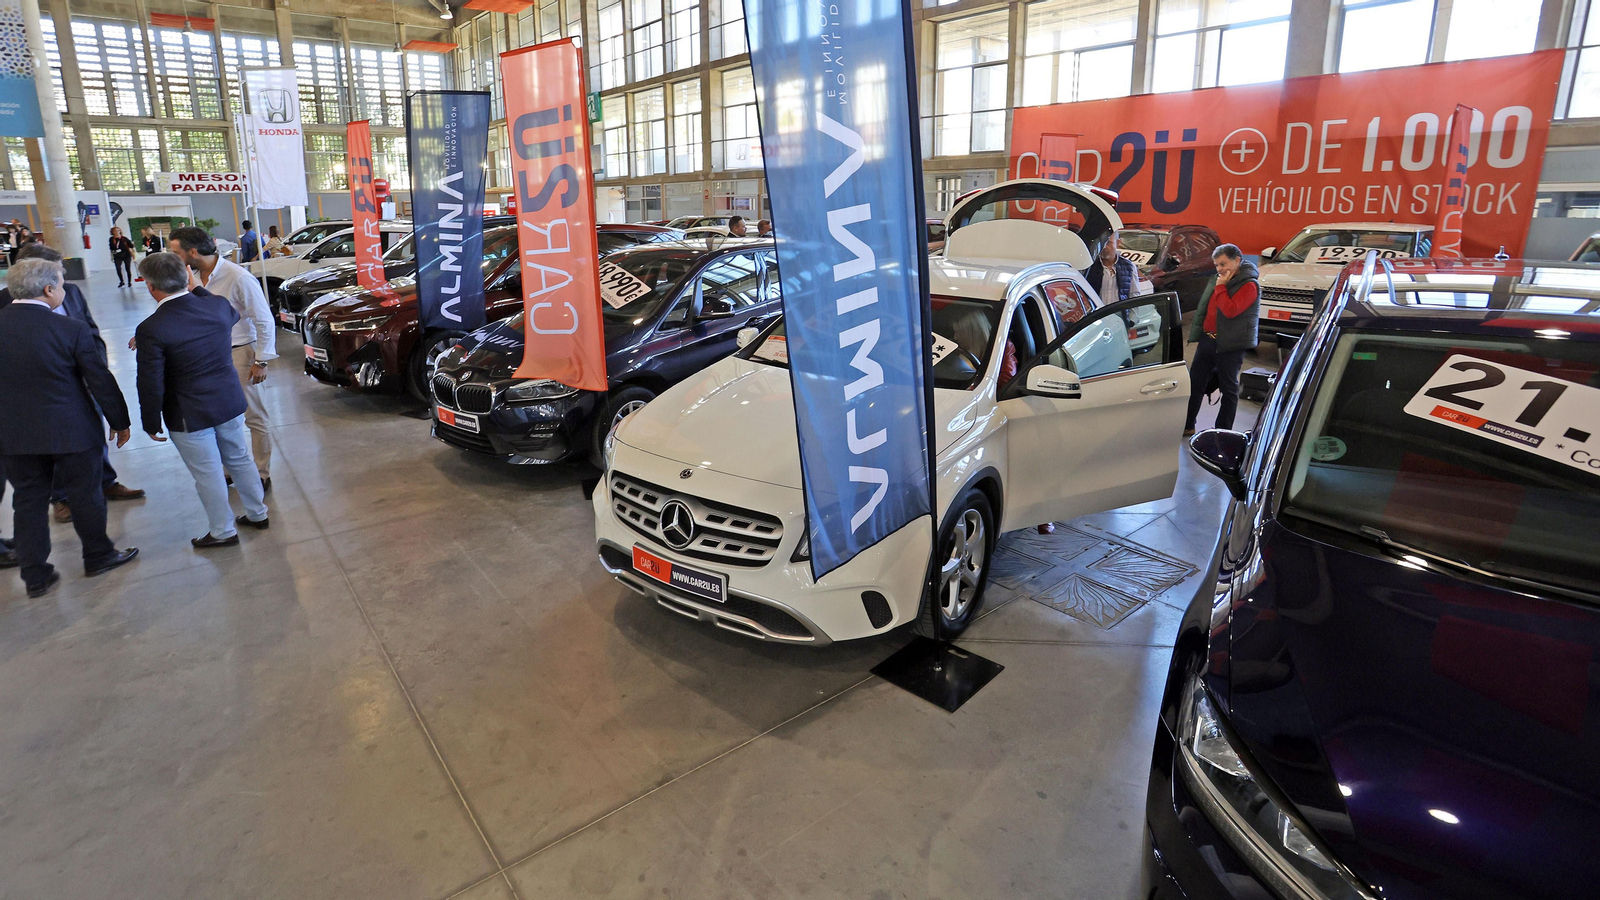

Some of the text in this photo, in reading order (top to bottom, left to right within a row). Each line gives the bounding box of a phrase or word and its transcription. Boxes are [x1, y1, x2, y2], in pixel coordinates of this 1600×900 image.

[1016, 128, 1198, 215] CR2Ü
[1281, 119, 1348, 175] DE
[1362, 105, 1533, 173] 1.000
[1218, 181, 1356, 215] VEHÍCULOS
[1363, 185, 1402, 214] EN
[437, 170, 464, 323] ALMINA
[671, 570, 720, 594] WWW.CAR2U.ES
